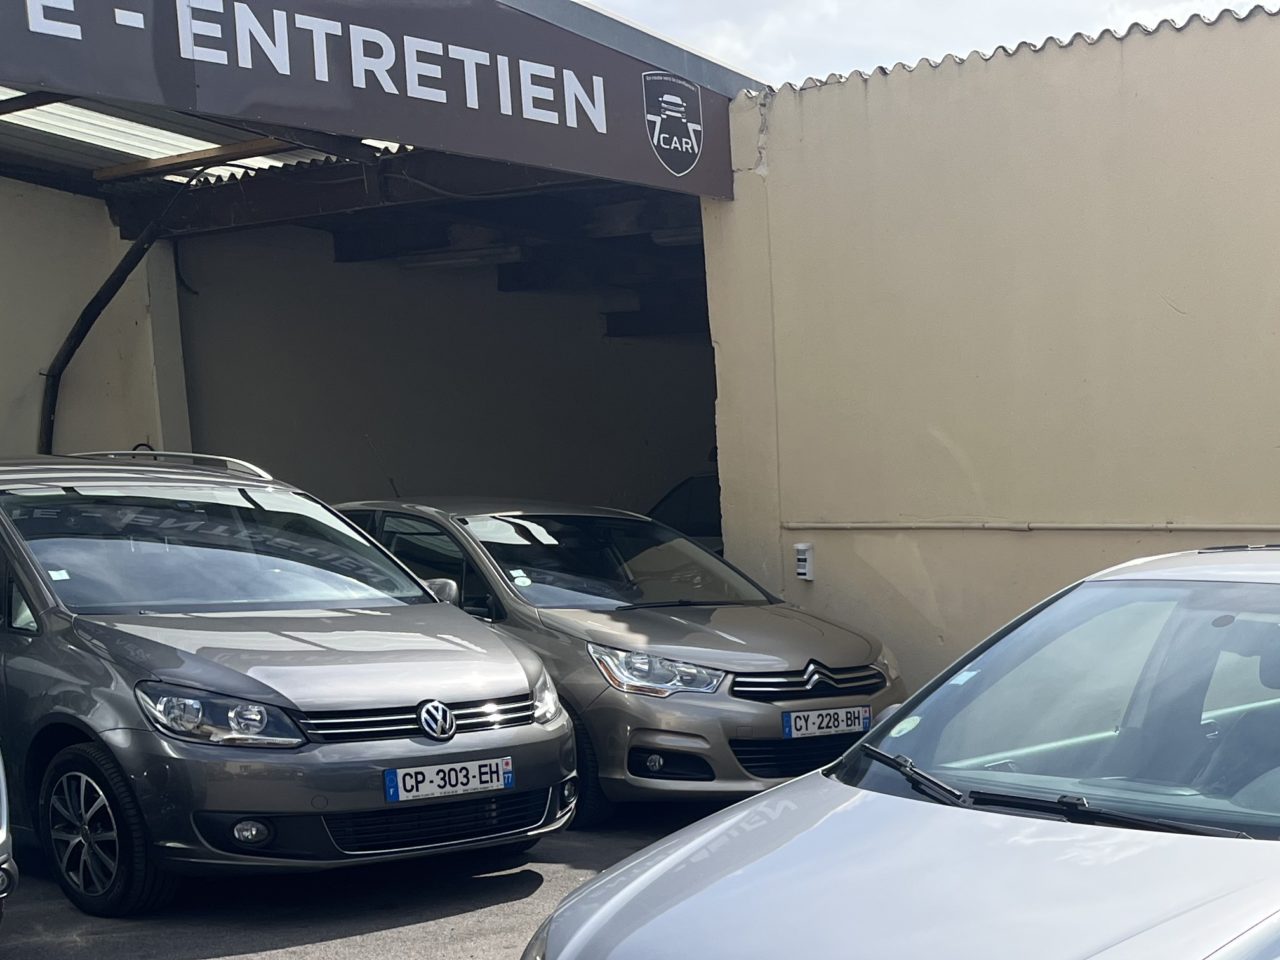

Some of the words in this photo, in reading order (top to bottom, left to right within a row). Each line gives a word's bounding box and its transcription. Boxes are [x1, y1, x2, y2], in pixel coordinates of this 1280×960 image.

[176, 0, 607, 134] ENTRETIEN
[794, 710, 860, 732] CY-228-BH
[402, 762, 500, 793] CP-303-EH
[503, 773, 513, 784] 77
